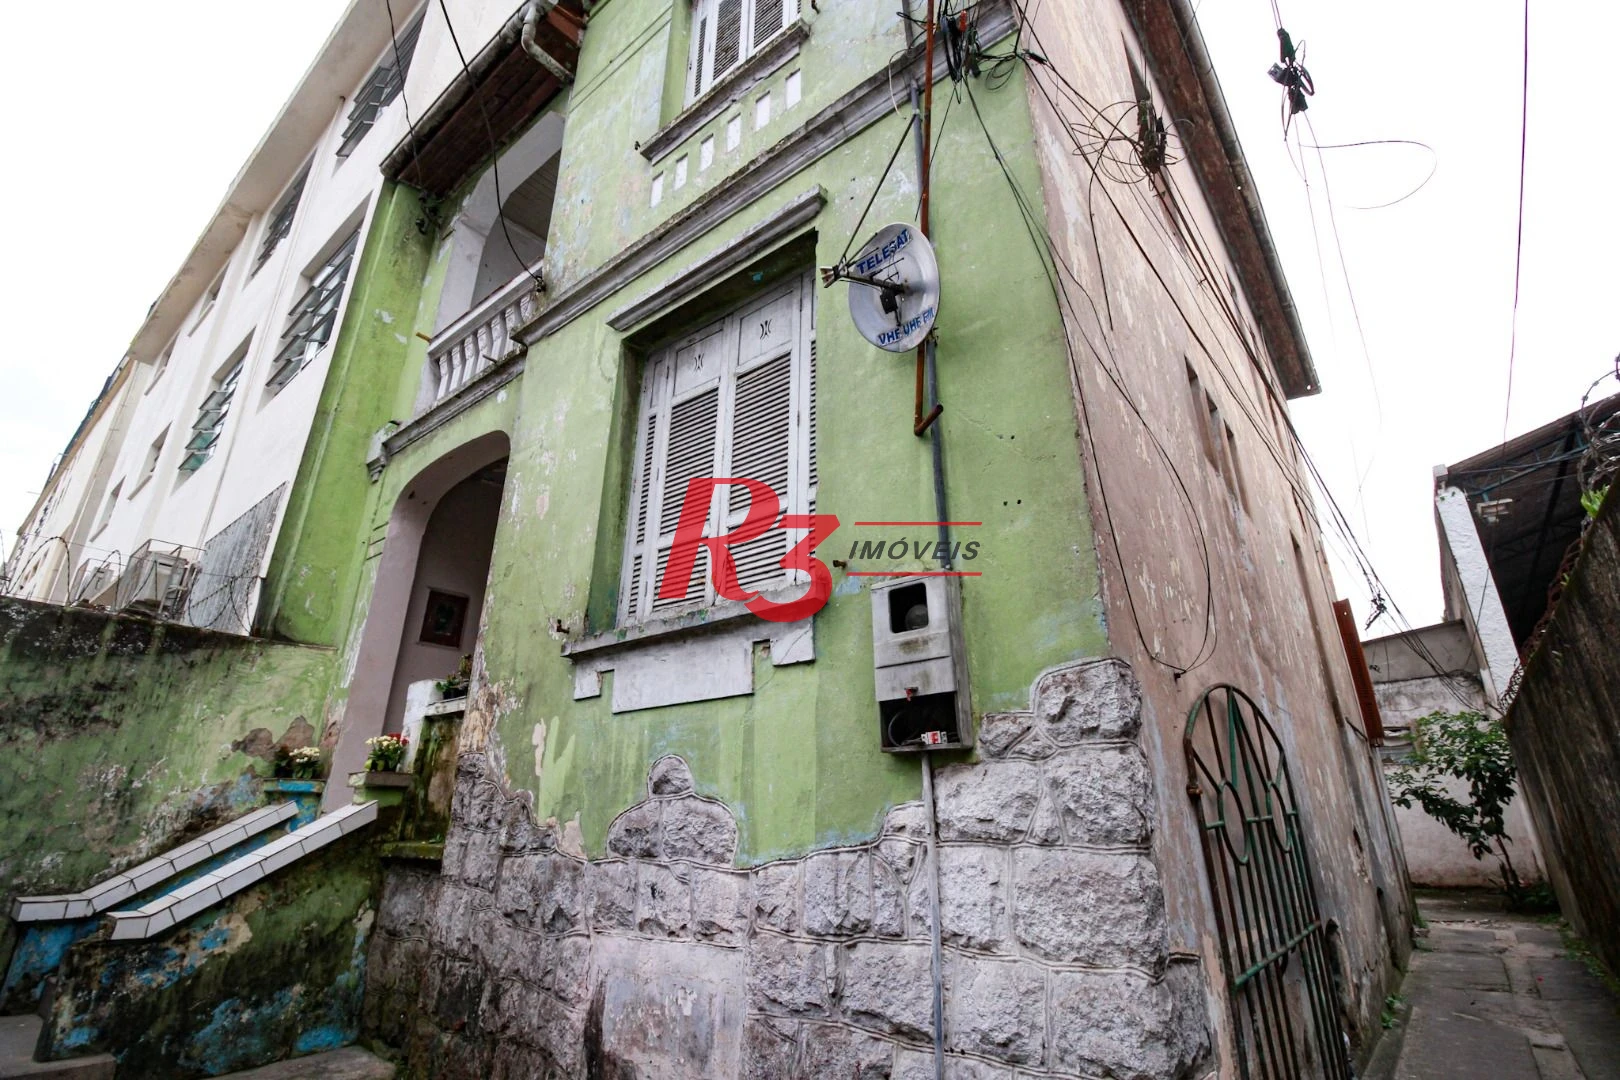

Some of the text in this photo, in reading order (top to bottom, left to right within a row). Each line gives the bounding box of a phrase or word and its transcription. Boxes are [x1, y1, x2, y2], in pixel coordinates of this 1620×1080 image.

[856, 229, 909, 274] TELESAT
[878, 328, 901, 344] VHF
[903, 316, 921, 335] UHF
